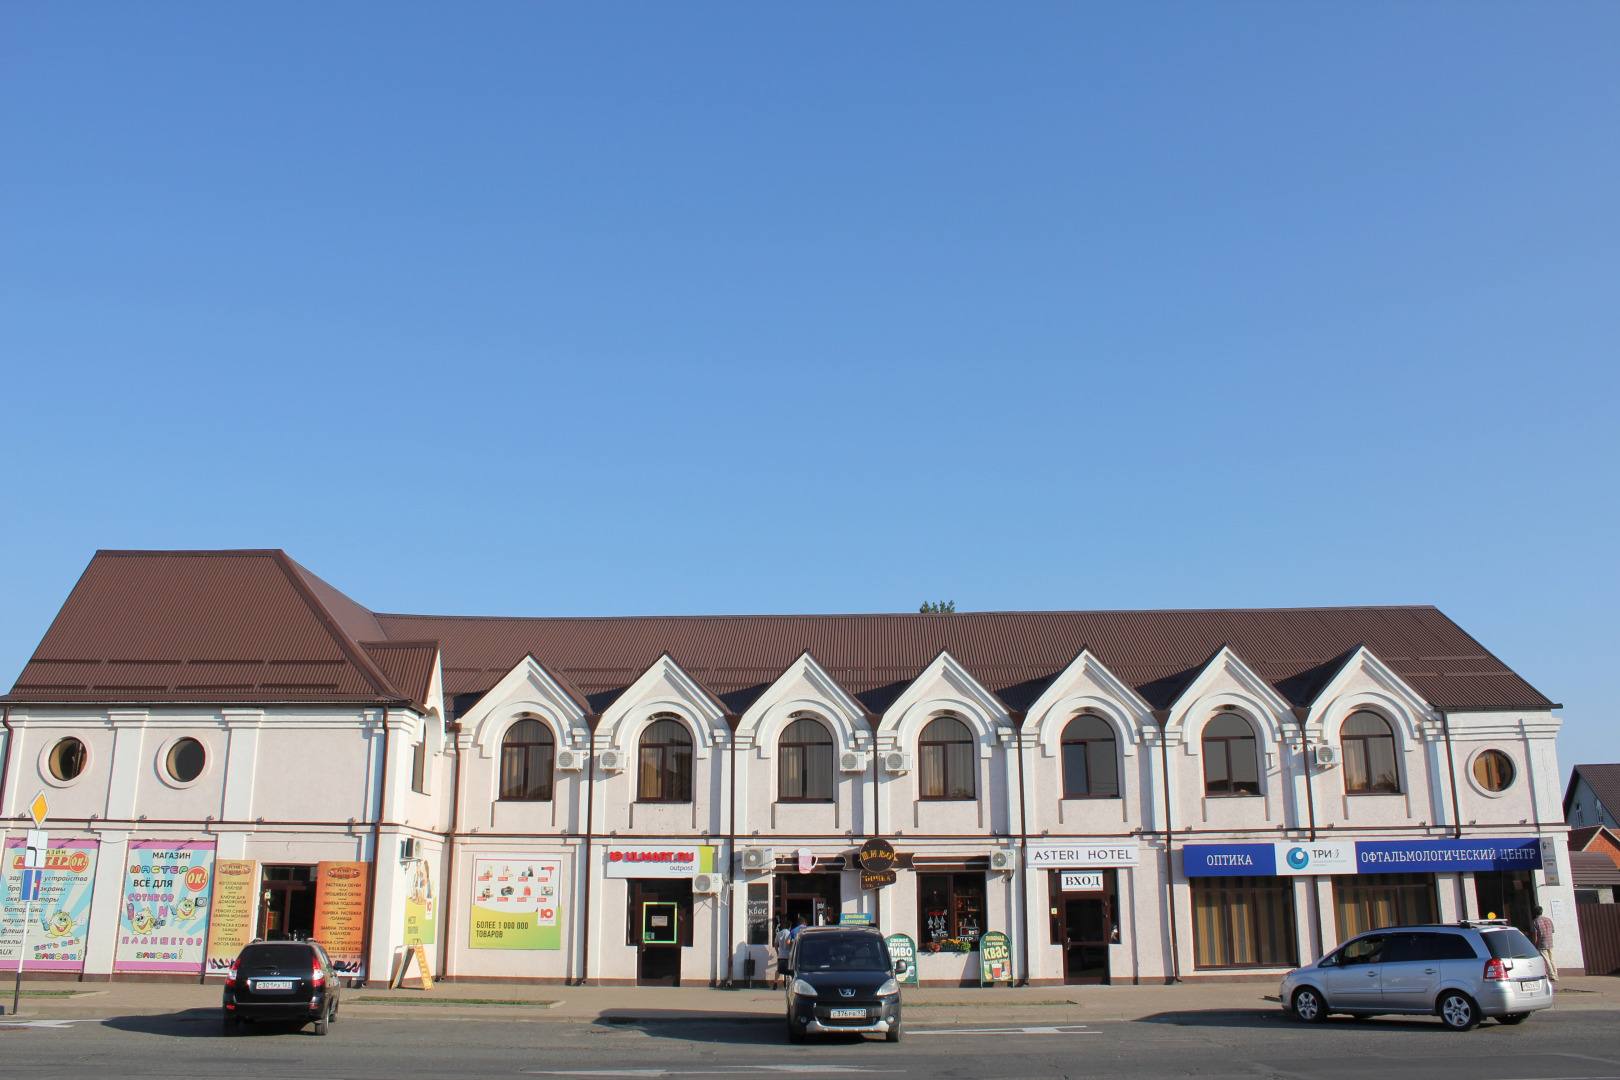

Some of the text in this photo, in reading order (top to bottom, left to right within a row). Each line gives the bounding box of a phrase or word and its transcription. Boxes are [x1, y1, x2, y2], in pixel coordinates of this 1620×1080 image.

[626, 852, 694, 862] ULMART.RU
[1034, 850, 1132, 860] ASTERI HOTEL
[1206, 854, 1254, 866] ОПТИКА
[1361, 848, 1496, 863] ОФТАЛЬМОЛОГИЧЕСКИЙ
[1500, 848, 1536, 862] ЦЕНТР
[130, 865, 188, 874] МАСТЕР
[134, 877, 172, 888] ВСЁ ДЛЯ
[1065, 876, 1100, 887] ВХОД
[128, 893, 174, 902] СОТИКОВ
[4, 906, 43, 914] батарйки
[158, 906, 168, 917] И
[476, 930, 504, 938] ТОВАРОВ
[122, 936, 202, 946] ПЛАНШЕТОВ
